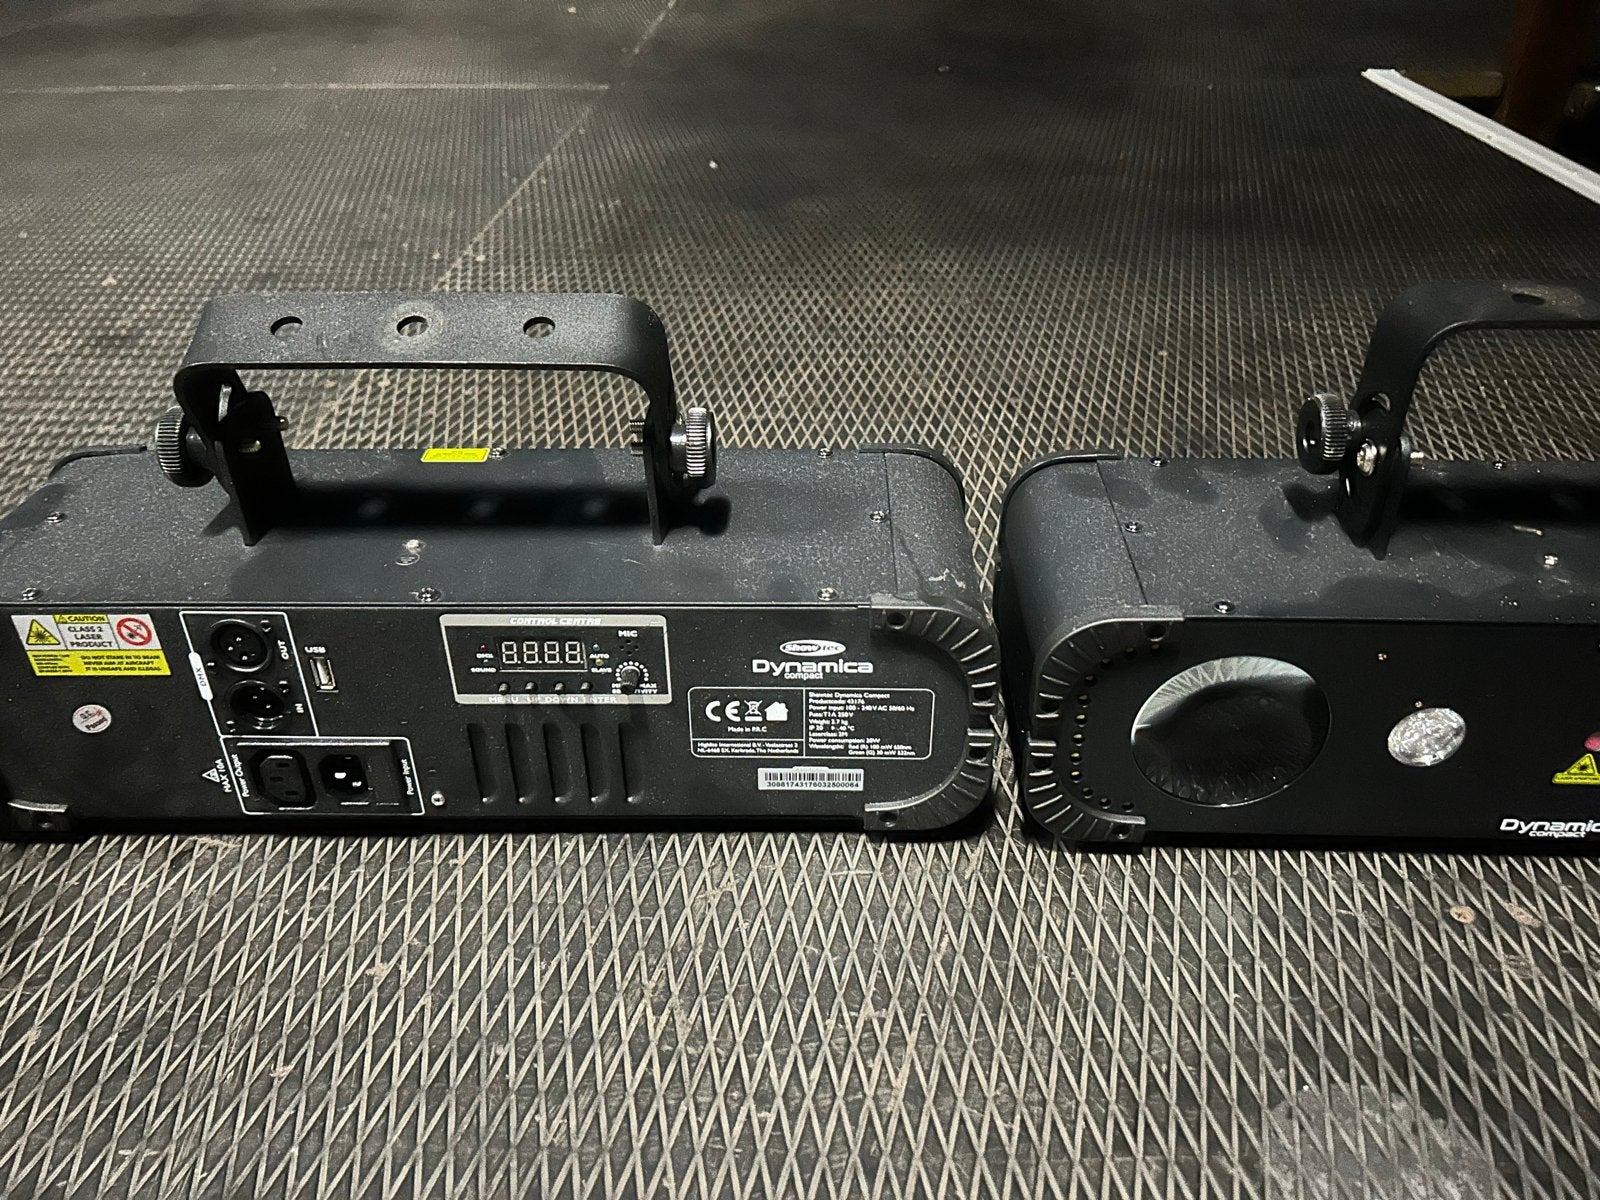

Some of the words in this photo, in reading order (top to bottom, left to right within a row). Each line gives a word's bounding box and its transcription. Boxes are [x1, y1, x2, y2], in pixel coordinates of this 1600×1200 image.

[510, 617, 558, 625] CONTROL
[559, 617, 601, 625] CENTRE
[277, 640, 290, 660] OUT
[752, 659, 874, 676] Dynamica
[784, 672, 823, 680] compact
[295, 703, 304, 713] IN
[215, 758, 226, 772] 10A
[231, 754, 243, 777] Output
[401, 759, 411, 775] Input
[220, 774, 232, 793] MAX
[239, 778, 250, 797] Power
[405, 775, 415, 795] Power
[1500, 819, 1600, 834] Dynamic
[1529, 831, 1586, 839] compact
